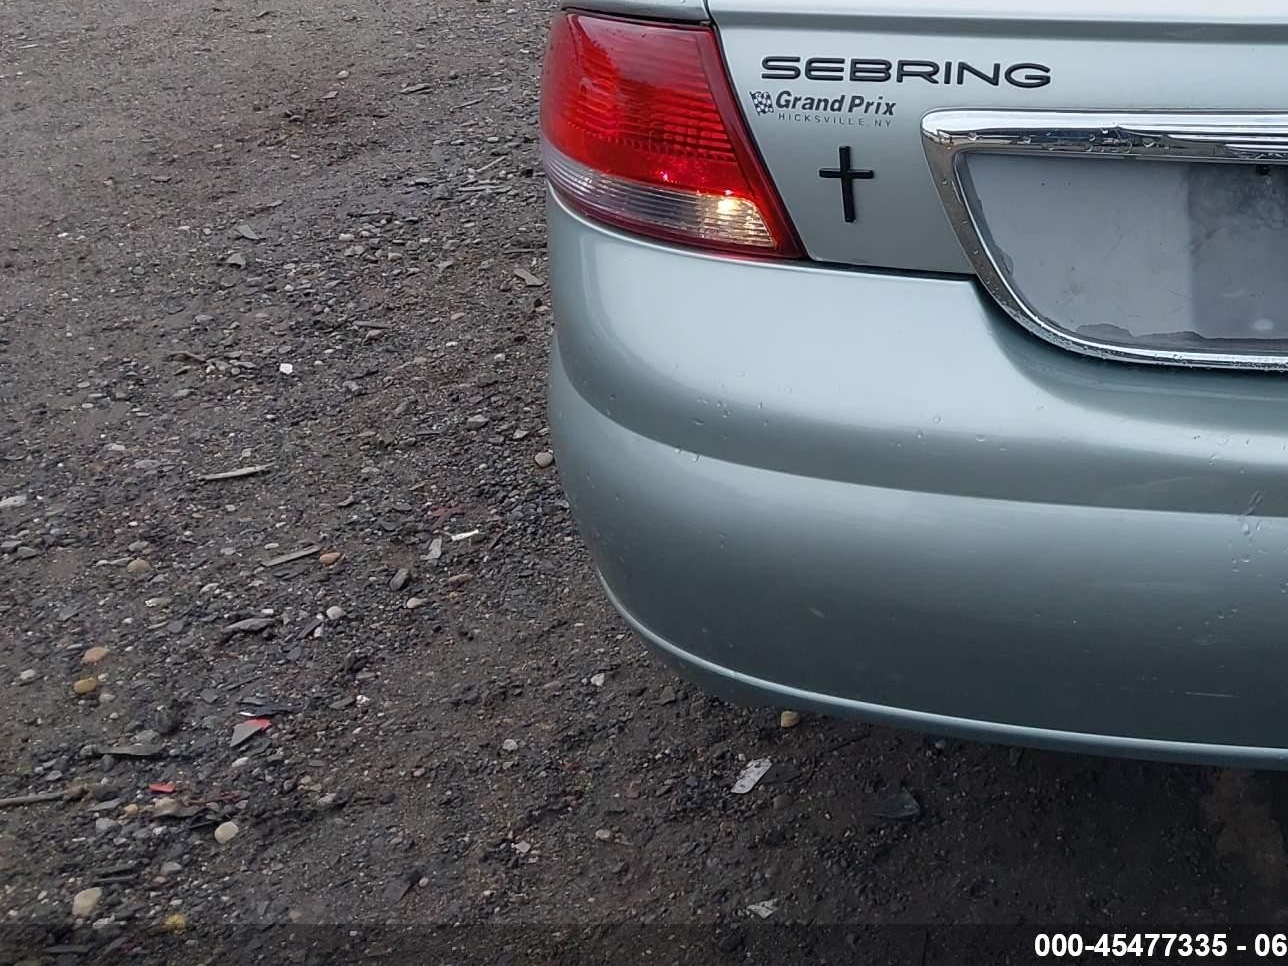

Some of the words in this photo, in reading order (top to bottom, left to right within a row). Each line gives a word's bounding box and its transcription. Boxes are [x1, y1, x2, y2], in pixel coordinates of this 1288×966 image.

[761, 56, 1052, 89] SEBRING
[775, 90, 846, 113] Grand
[849, 95, 897, 116] Prix
[875, 118, 892, 128] NY
